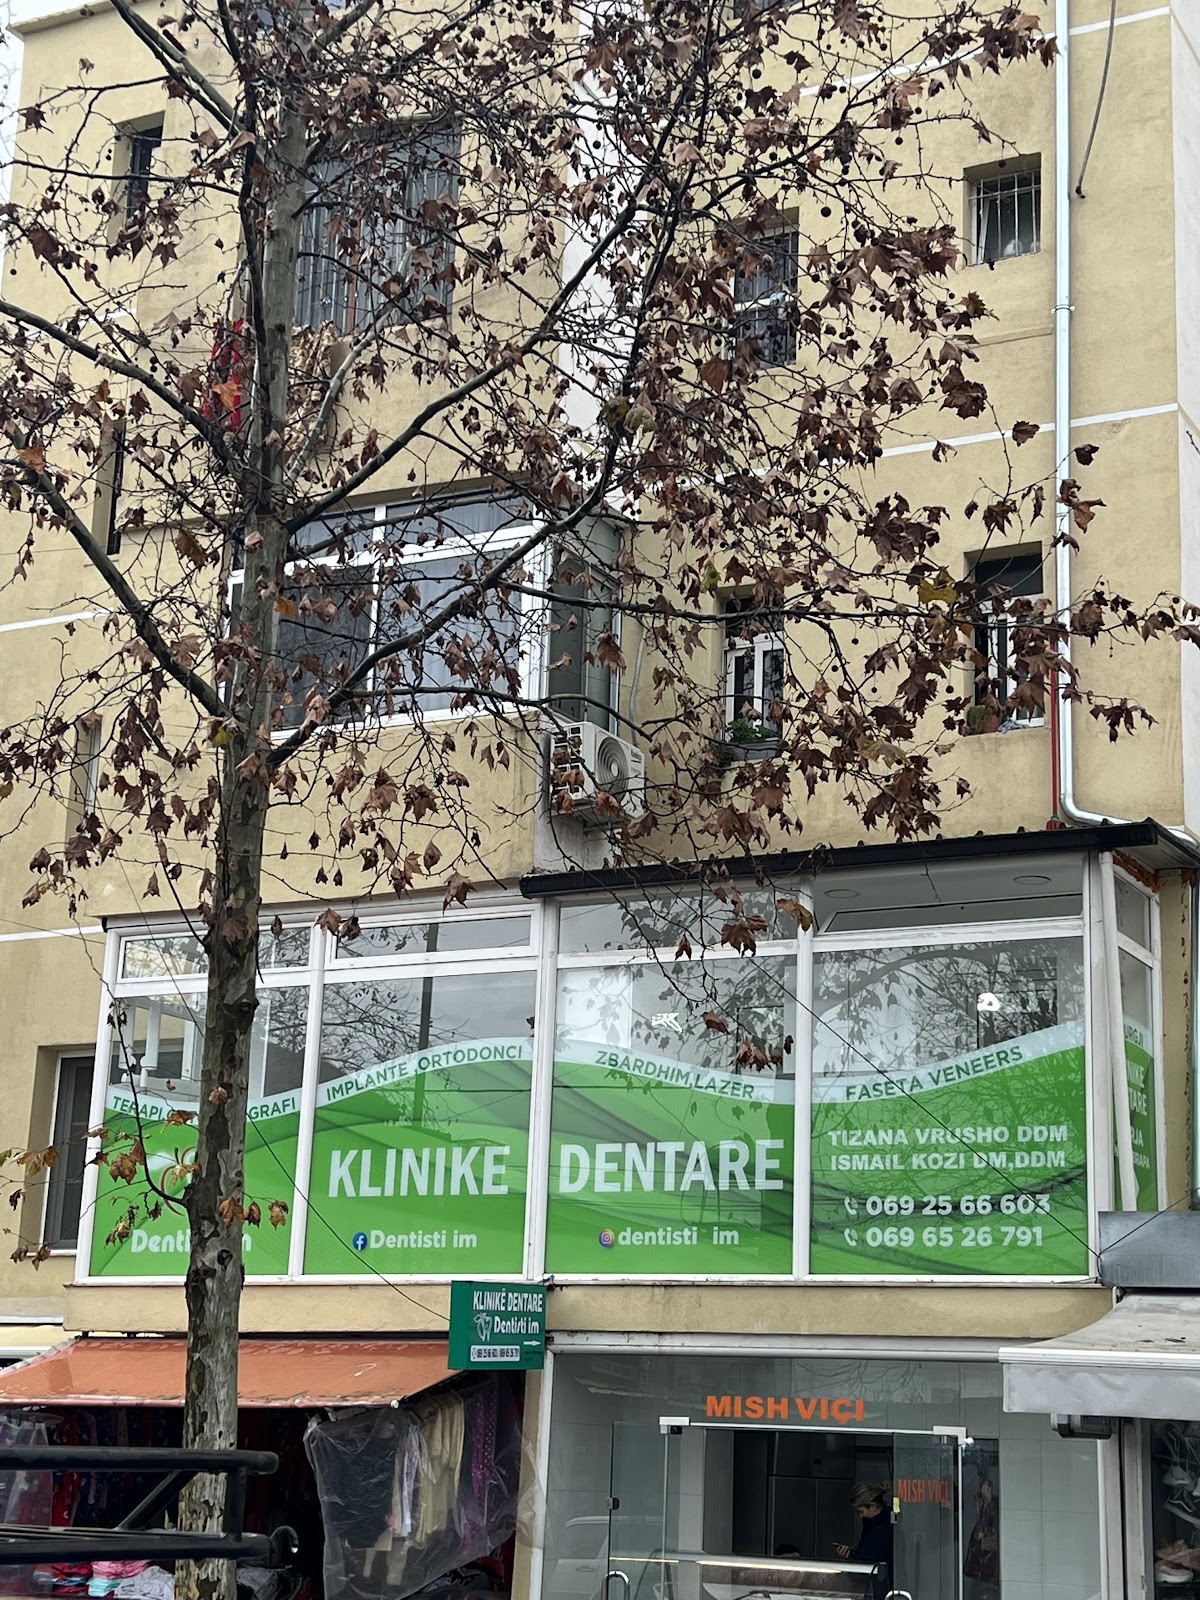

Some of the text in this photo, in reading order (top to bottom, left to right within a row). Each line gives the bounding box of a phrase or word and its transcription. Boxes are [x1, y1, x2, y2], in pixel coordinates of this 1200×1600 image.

[326, 1061, 409, 1101] IMPLANTE
[845, 1045, 1023, 1102] FASETA VENEERS
[828, 1125, 1068, 1146] TIZANA VRUSHO DDM
[328, 1139, 785, 1198] KLINIKE DENTARE
[830, 1151, 1066, 1171] ISMAIL KOZI DM,DDM
[865, 1194, 1051, 1216] 069 25 66 603
[369, 1229, 478, 1249] Dentisti im
[617, 1226, 740, 1246] dentisti im
[865, 1226, 1043, 1247] 069 65 26 791
[507, 1291, 543, 1313] DENTARE
[493, 1315, 540, 1334] Dentisti im
[705, 1395, 866, 1425] MISH VIÇI
[897, 1479, 925, 1503] MISH
